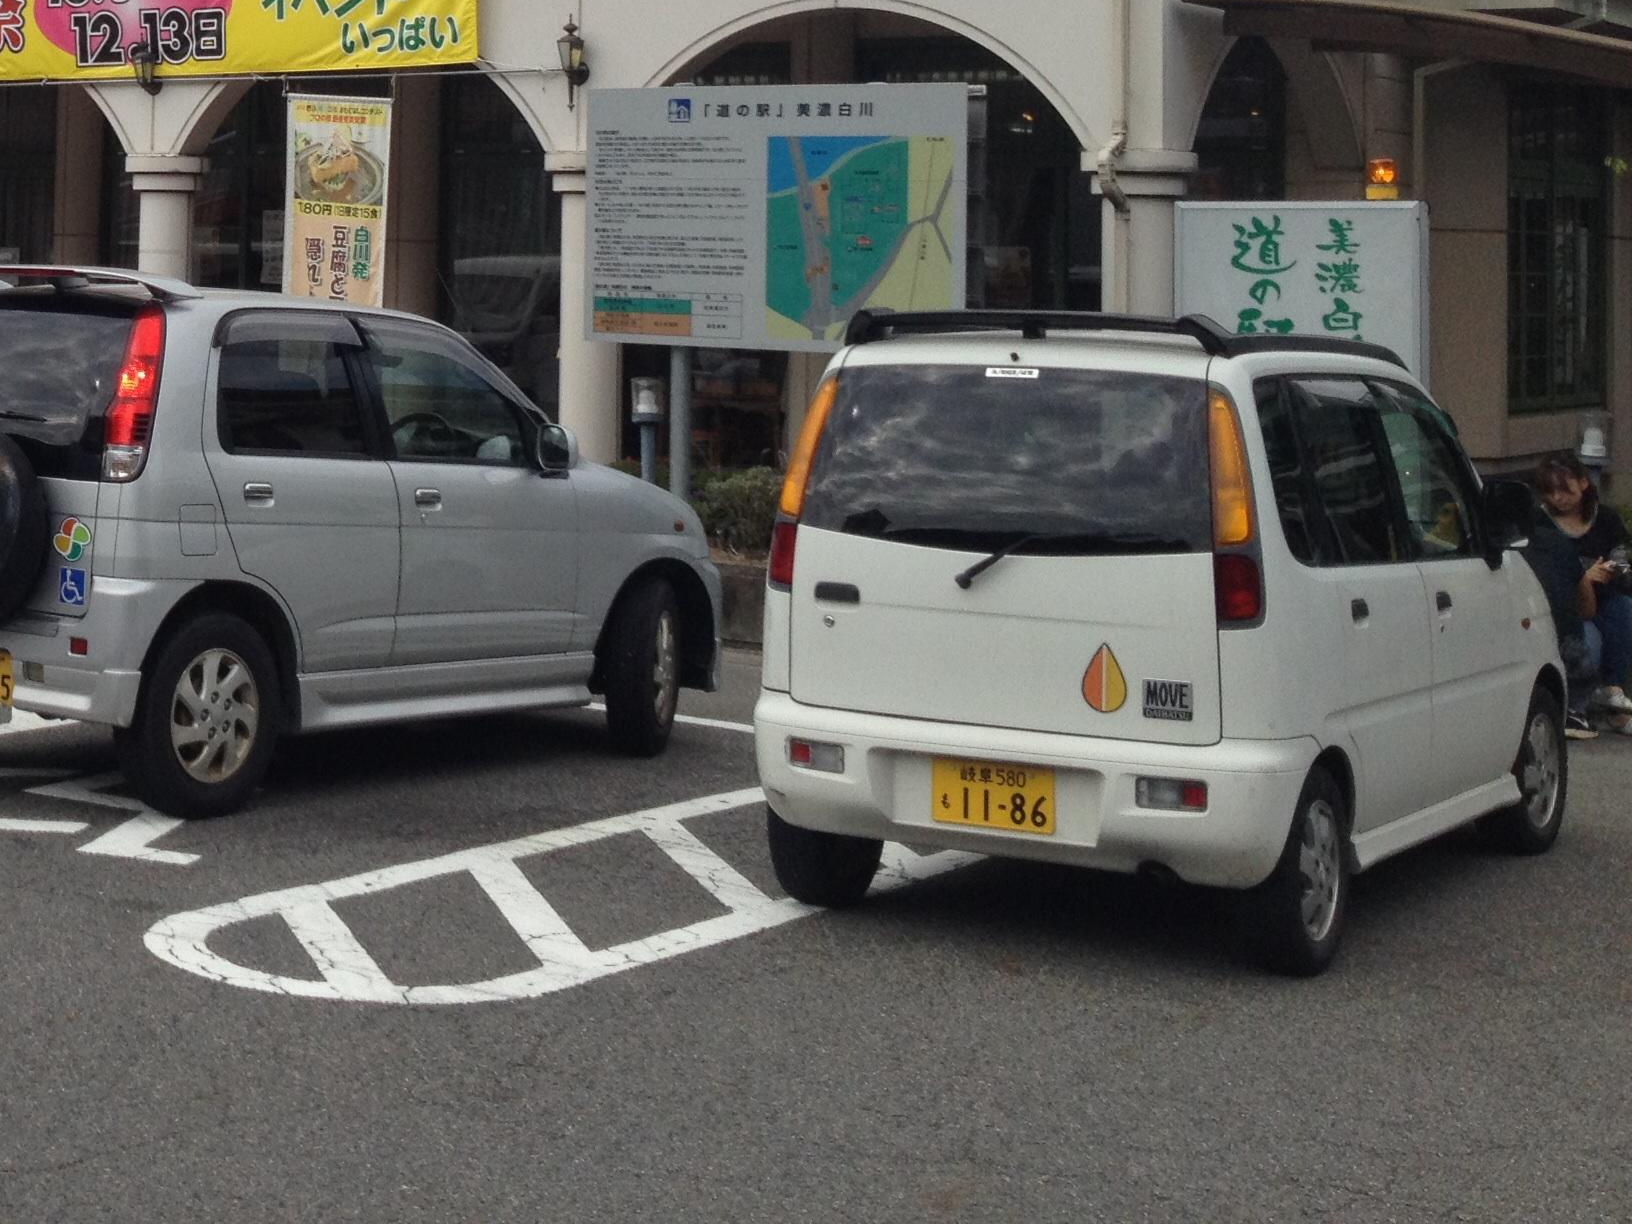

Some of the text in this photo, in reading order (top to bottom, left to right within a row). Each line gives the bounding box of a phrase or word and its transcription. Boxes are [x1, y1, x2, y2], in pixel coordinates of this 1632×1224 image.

[339, 14, 461, 56] いっぱい
[1314, 217, 1365, 342] 美濃白
[1146, 680, 1189, 709] MOVE
[963, 786, 1047, 828] 11-86
